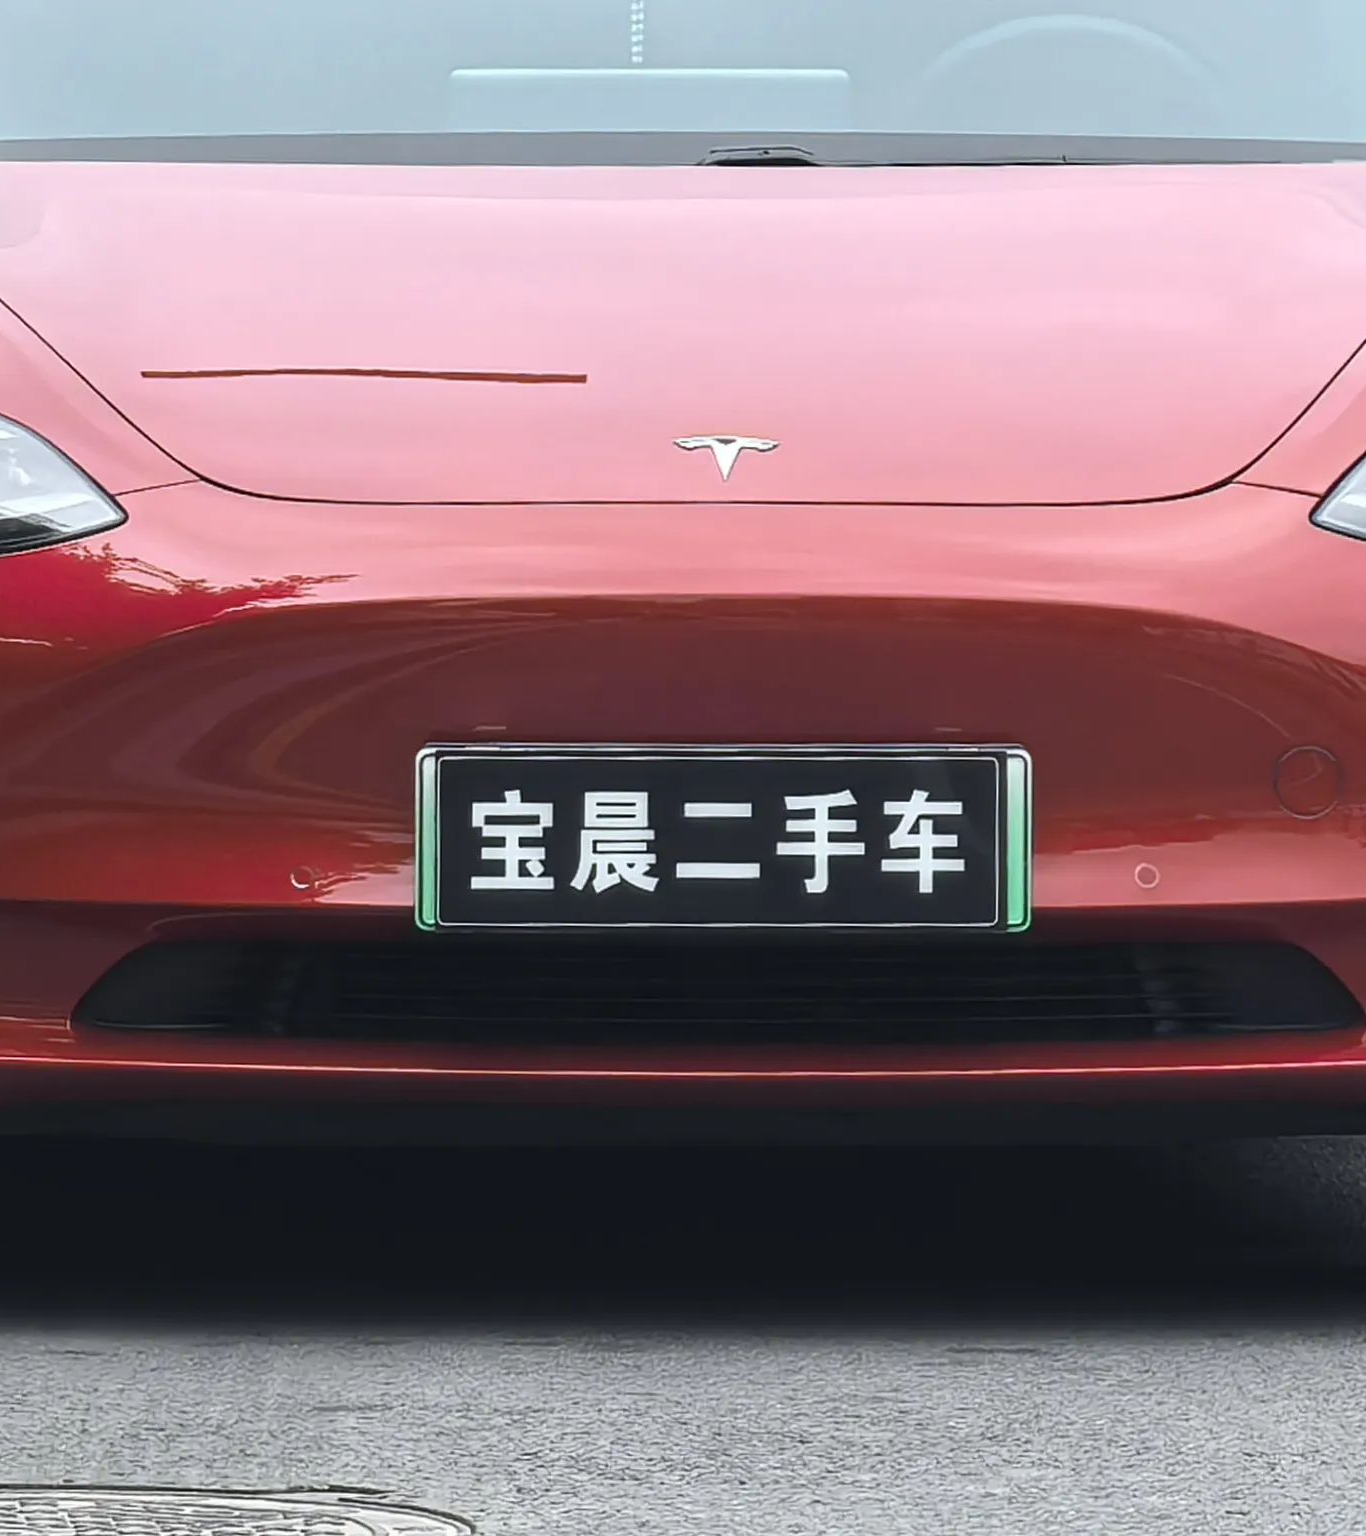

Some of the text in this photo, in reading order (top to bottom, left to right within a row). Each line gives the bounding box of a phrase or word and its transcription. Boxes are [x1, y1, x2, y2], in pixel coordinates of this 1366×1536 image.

[470, 790, 965, 894] 宝晨二手车
